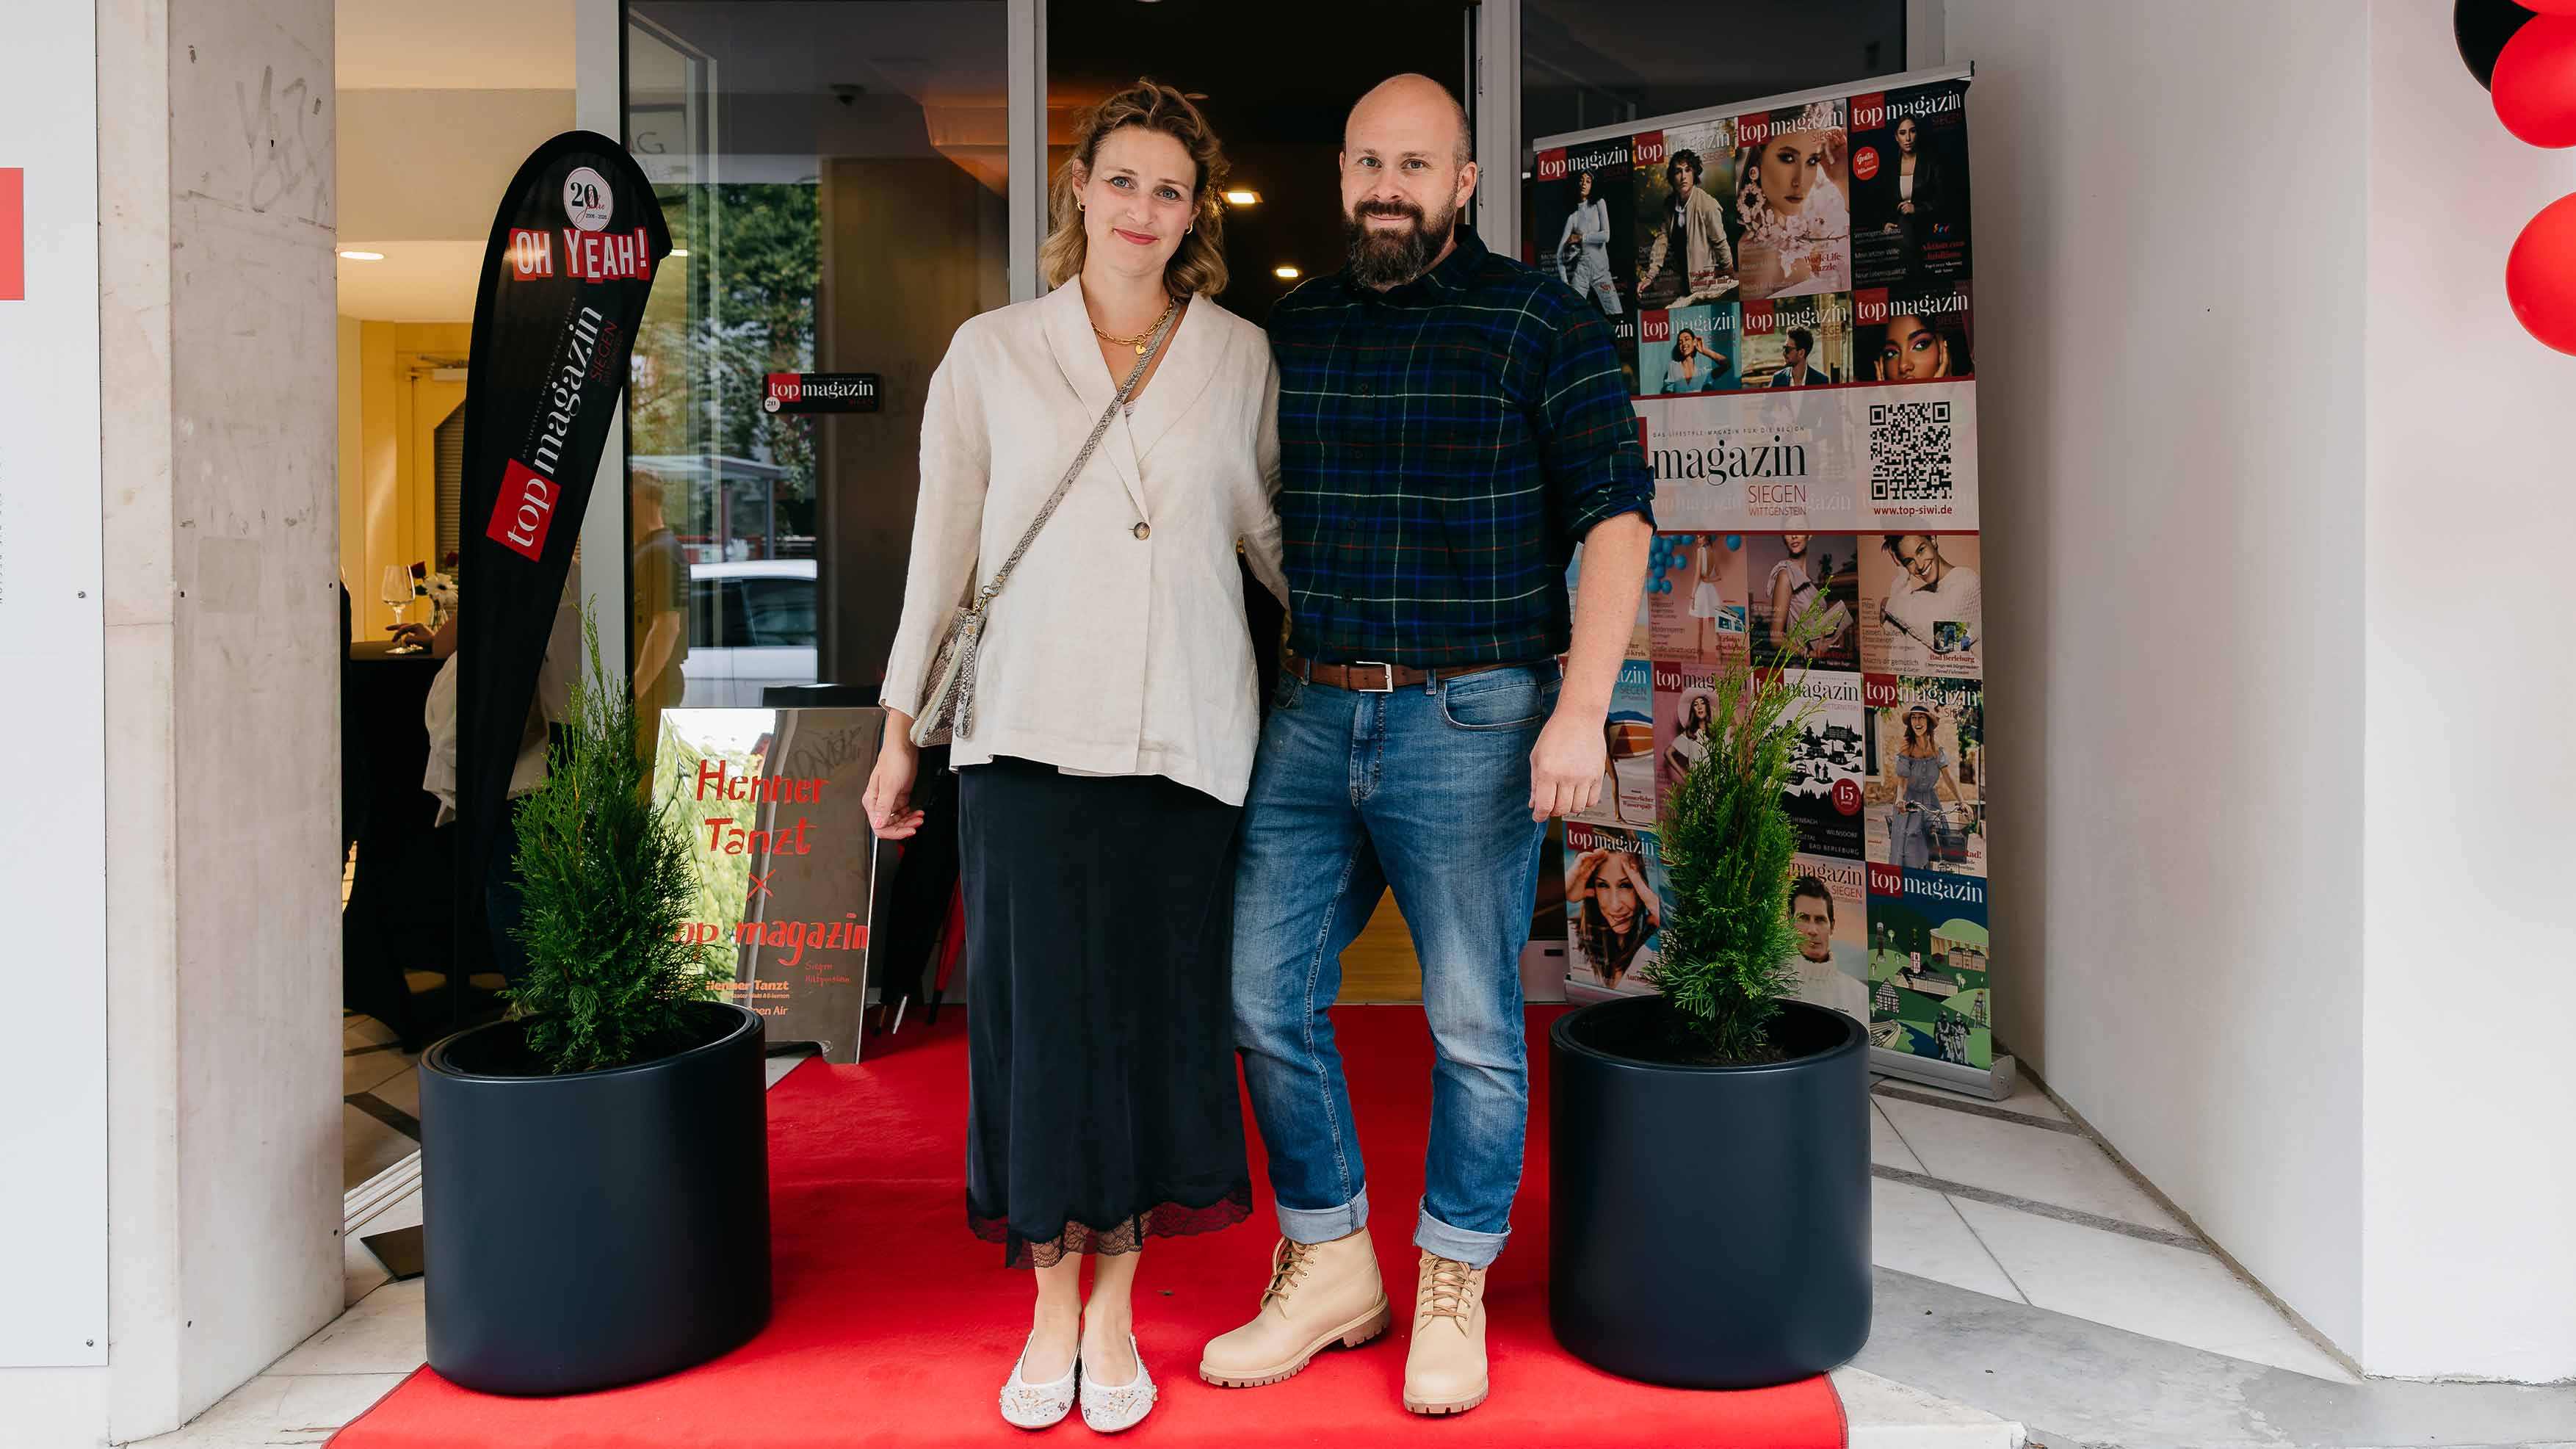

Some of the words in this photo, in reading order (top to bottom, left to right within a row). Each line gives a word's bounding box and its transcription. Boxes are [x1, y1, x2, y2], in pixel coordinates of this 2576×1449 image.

[1853, 106, 1883, 126] top
[1886, 91, 1961, 120] magazin
[1740, 122, 1768, 142] top
[1770, 109, 1844, 137] magazin
[1638, 143, 1663, 162] top
[1665, 131, 1730, 156] magazin
[1540, 159, 1566, 177] top
[1568, 146, 1629, 173] magazin
[570, 181, 599, 209] 20
[515, 231, 553, 274] OH
[562, 229, 647, 278] YEAH!
[1746, 314, 1772, 331] top
[1776, 303, 1847, 328] magazin
[1858, 302, 1886, 322] top
[1891, 290, 1969, 318] magazin
[1643, 321, 1668, 339] top
[1671, 311, 1736, 334] magazin
[771, 382, 800, 400] top
[802, 380, 875, 400] magazin
[507, 477, 551, 548] top
[534, 304, 604, 477] magazin
[1651, 435, 1809, 487] magazin
[1748, 485, 1806, 504] SIEGEN
[1749, 506, 1807, 517] WITTGENSTEIN
[1873, 505, 1953, 517] www.top-siwi.de
[1656, 669, 1682, 690] top
[1683, 671, 1747, 692] magn
[1785, 680, 1859, 702] magazin
[1866, 681, 1896, 704] top
[1899, 685, 1980, 707] magazin
[696, 759, 833, 804] Henner
[1839, 785, 1854, 801] 15
[704, 817, 817, 856] Tanzt
[1568, 828, 1592, 850] top
[1594, 834, 1654, 856] magazin
[1790, 862, 1863, 886] magazin
[1870, 869, 1901, 894] top
[1904, 878, 1983, 904] magazin
[1831, 885, 1863, 898] SIEGEN
[658, 921, 719, 961] op
[735, 912, 869, 966] magazin
[704, 980, 753, 991] Henner
[753, 979, 790, 991] Tanzt
[773, 1005, 788, 1016] Air
